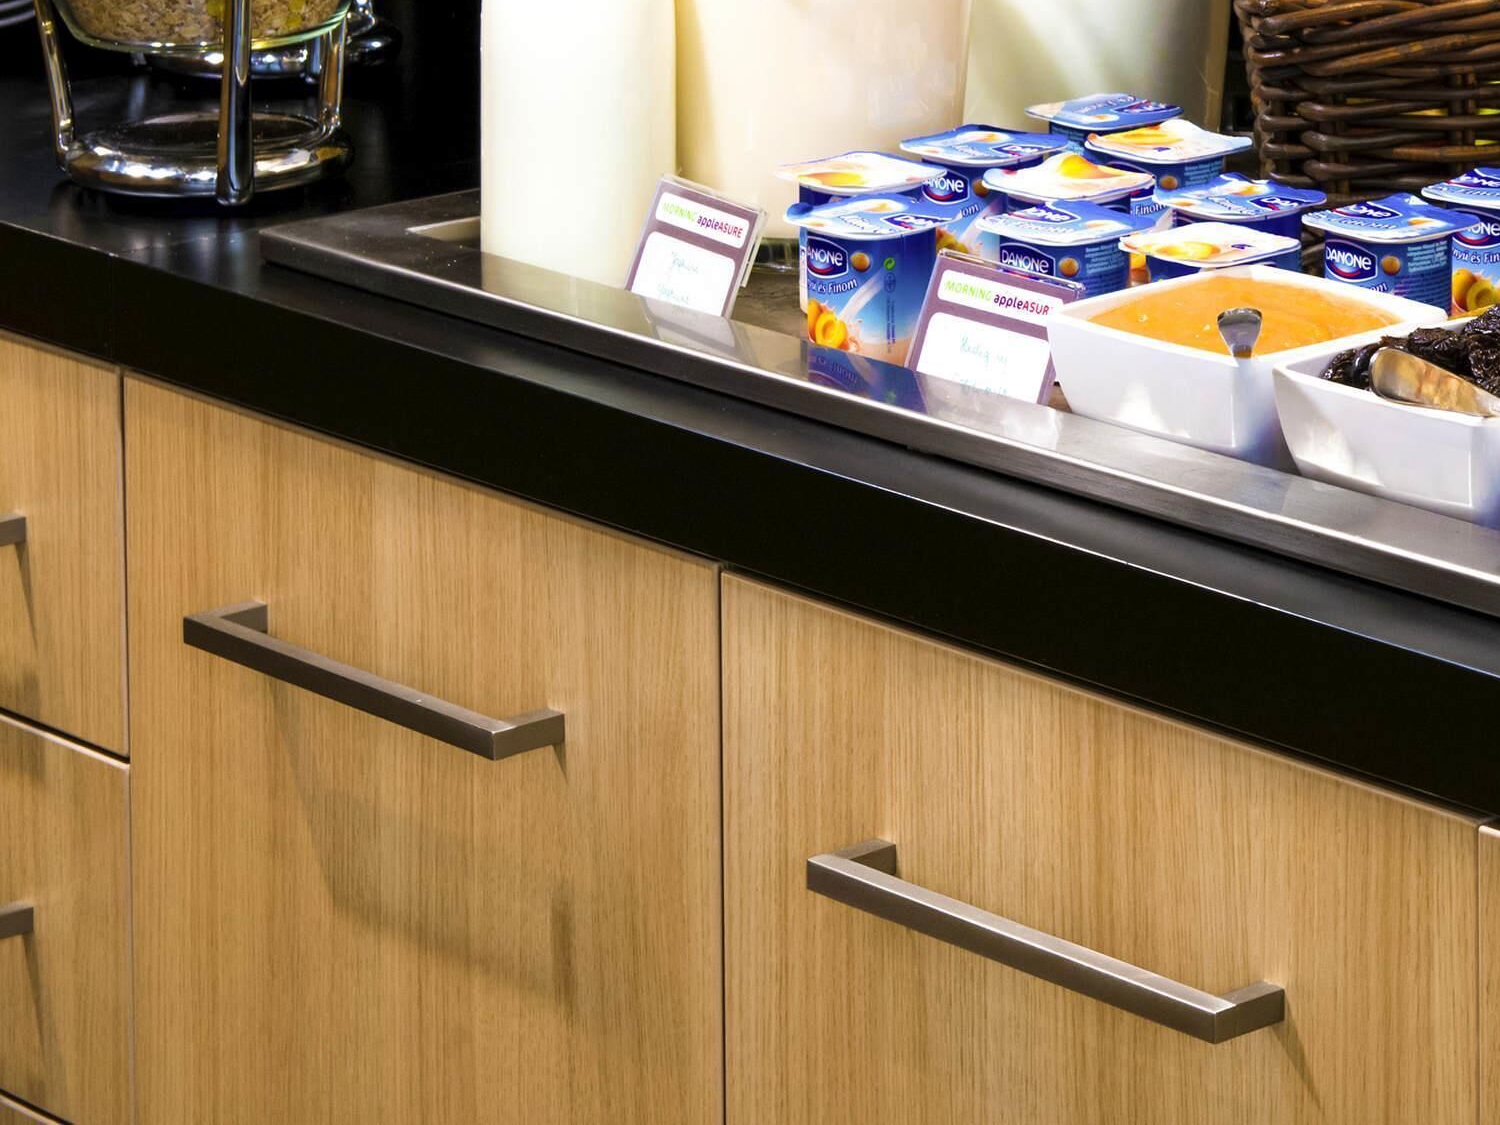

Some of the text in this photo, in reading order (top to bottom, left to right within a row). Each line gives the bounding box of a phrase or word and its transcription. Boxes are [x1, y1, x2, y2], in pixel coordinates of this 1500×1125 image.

[697, 216, 743, 238] appleASURE
[945, 280, 1053, 315] MORNING appleASUR
